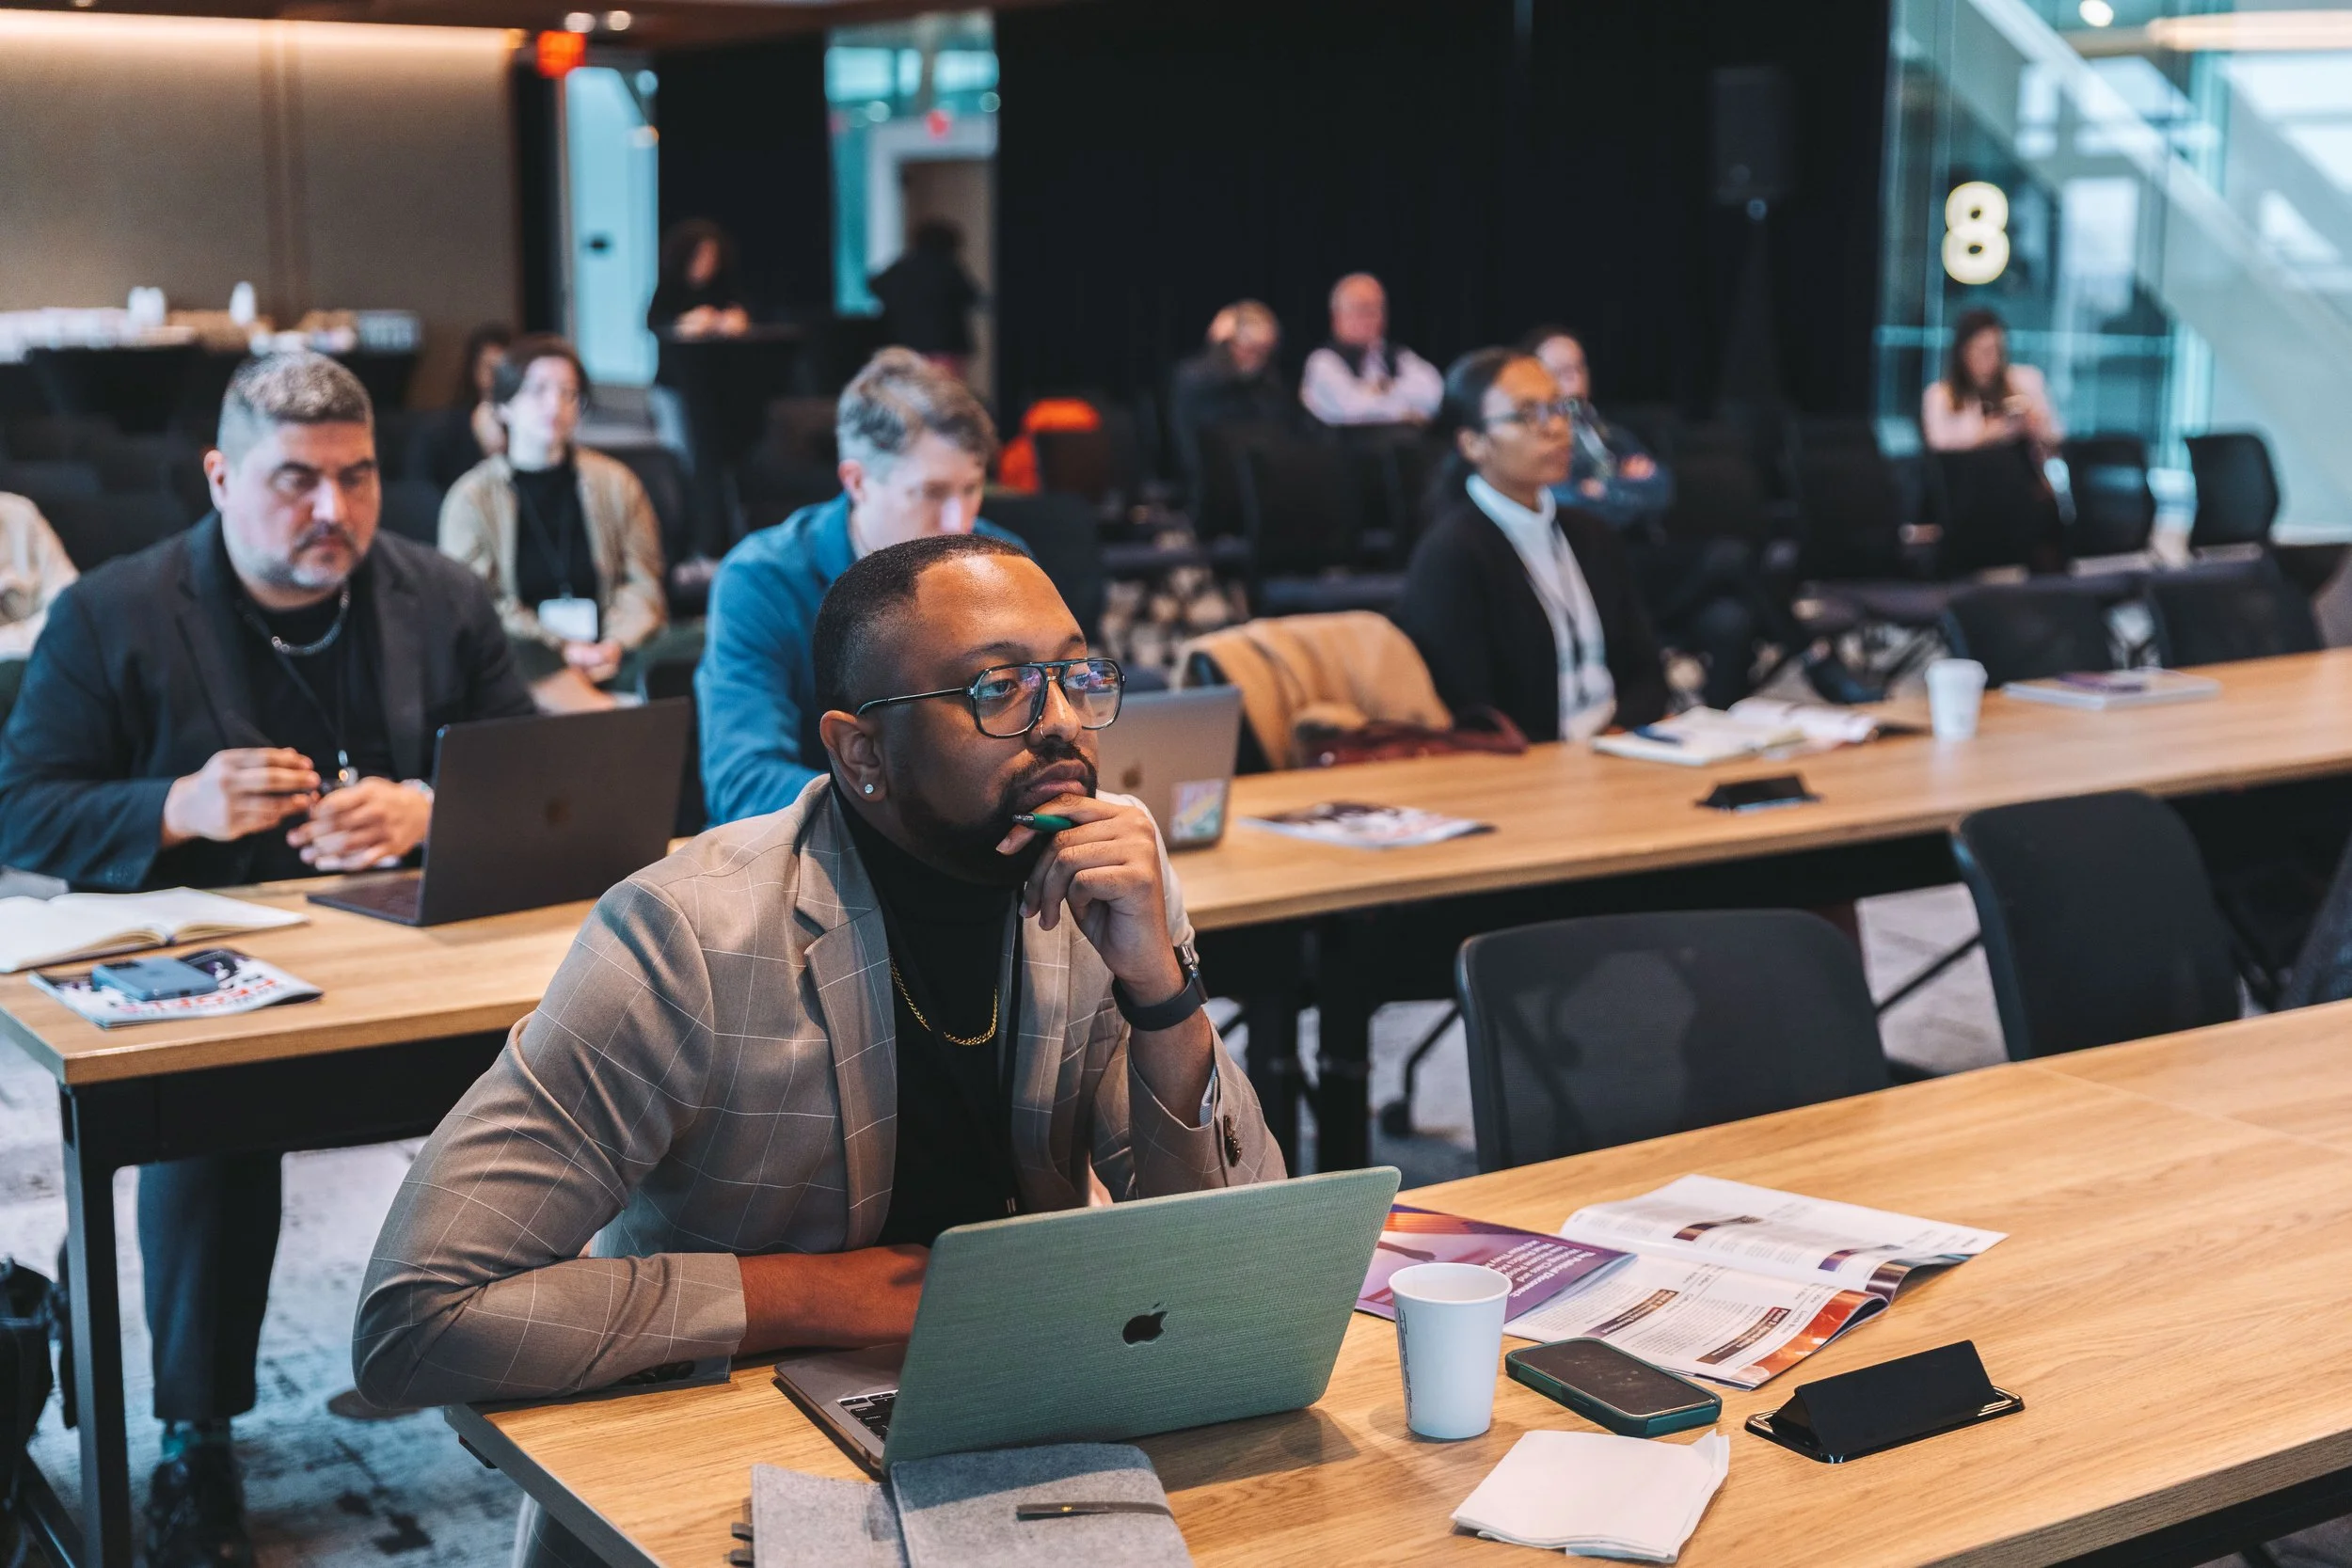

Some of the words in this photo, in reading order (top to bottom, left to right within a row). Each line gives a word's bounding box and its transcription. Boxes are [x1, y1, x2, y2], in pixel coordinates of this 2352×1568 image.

[1941, 181, 2010, 285] 8
[1548, 1257, 1582, 1274] Political
[1517, 1272, 1534, 1283] and
